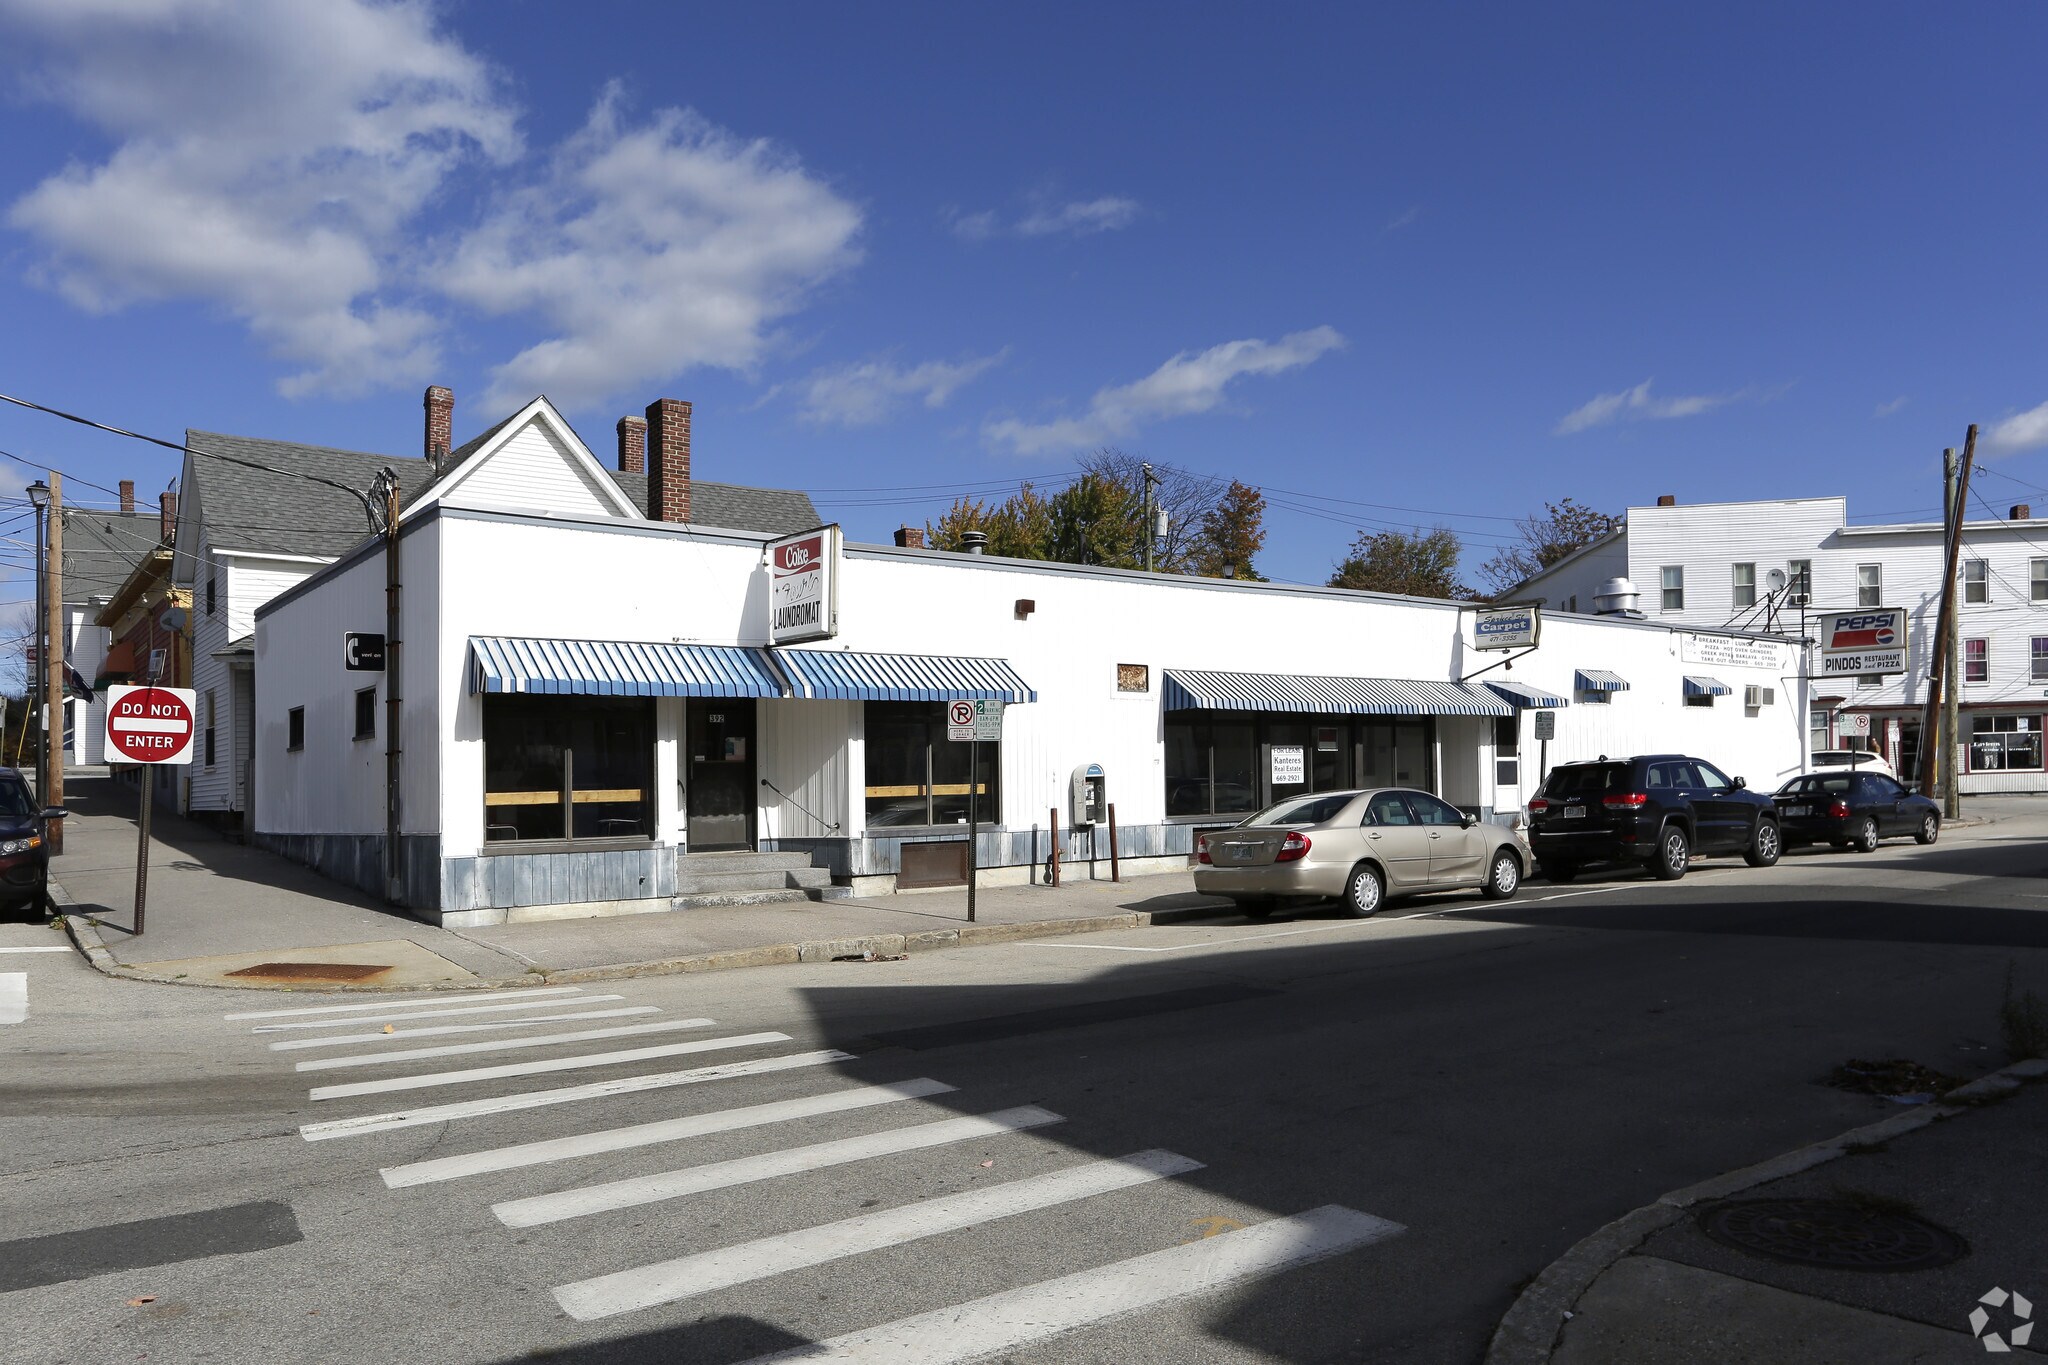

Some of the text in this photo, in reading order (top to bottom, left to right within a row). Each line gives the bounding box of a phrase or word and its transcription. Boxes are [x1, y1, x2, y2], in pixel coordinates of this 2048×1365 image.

[785, 545, 809, 568] Coke
[773, 600, 821, 630] LAUNDROMAT
[1834, 613, 1896, 631] PEPSI
[1480, 620, 1527, 632] Carpet
[1698, 637, 1729, 645] BREAKFAST
[1825, 653, 1900, 671] PINDOS RESTAURANT
[121, 702, 181, 717] DO NOT
[977, 703, 984, 714] 2
[709, 714, 724, 722] 392
[125, 735, 174, 748] ENTER
